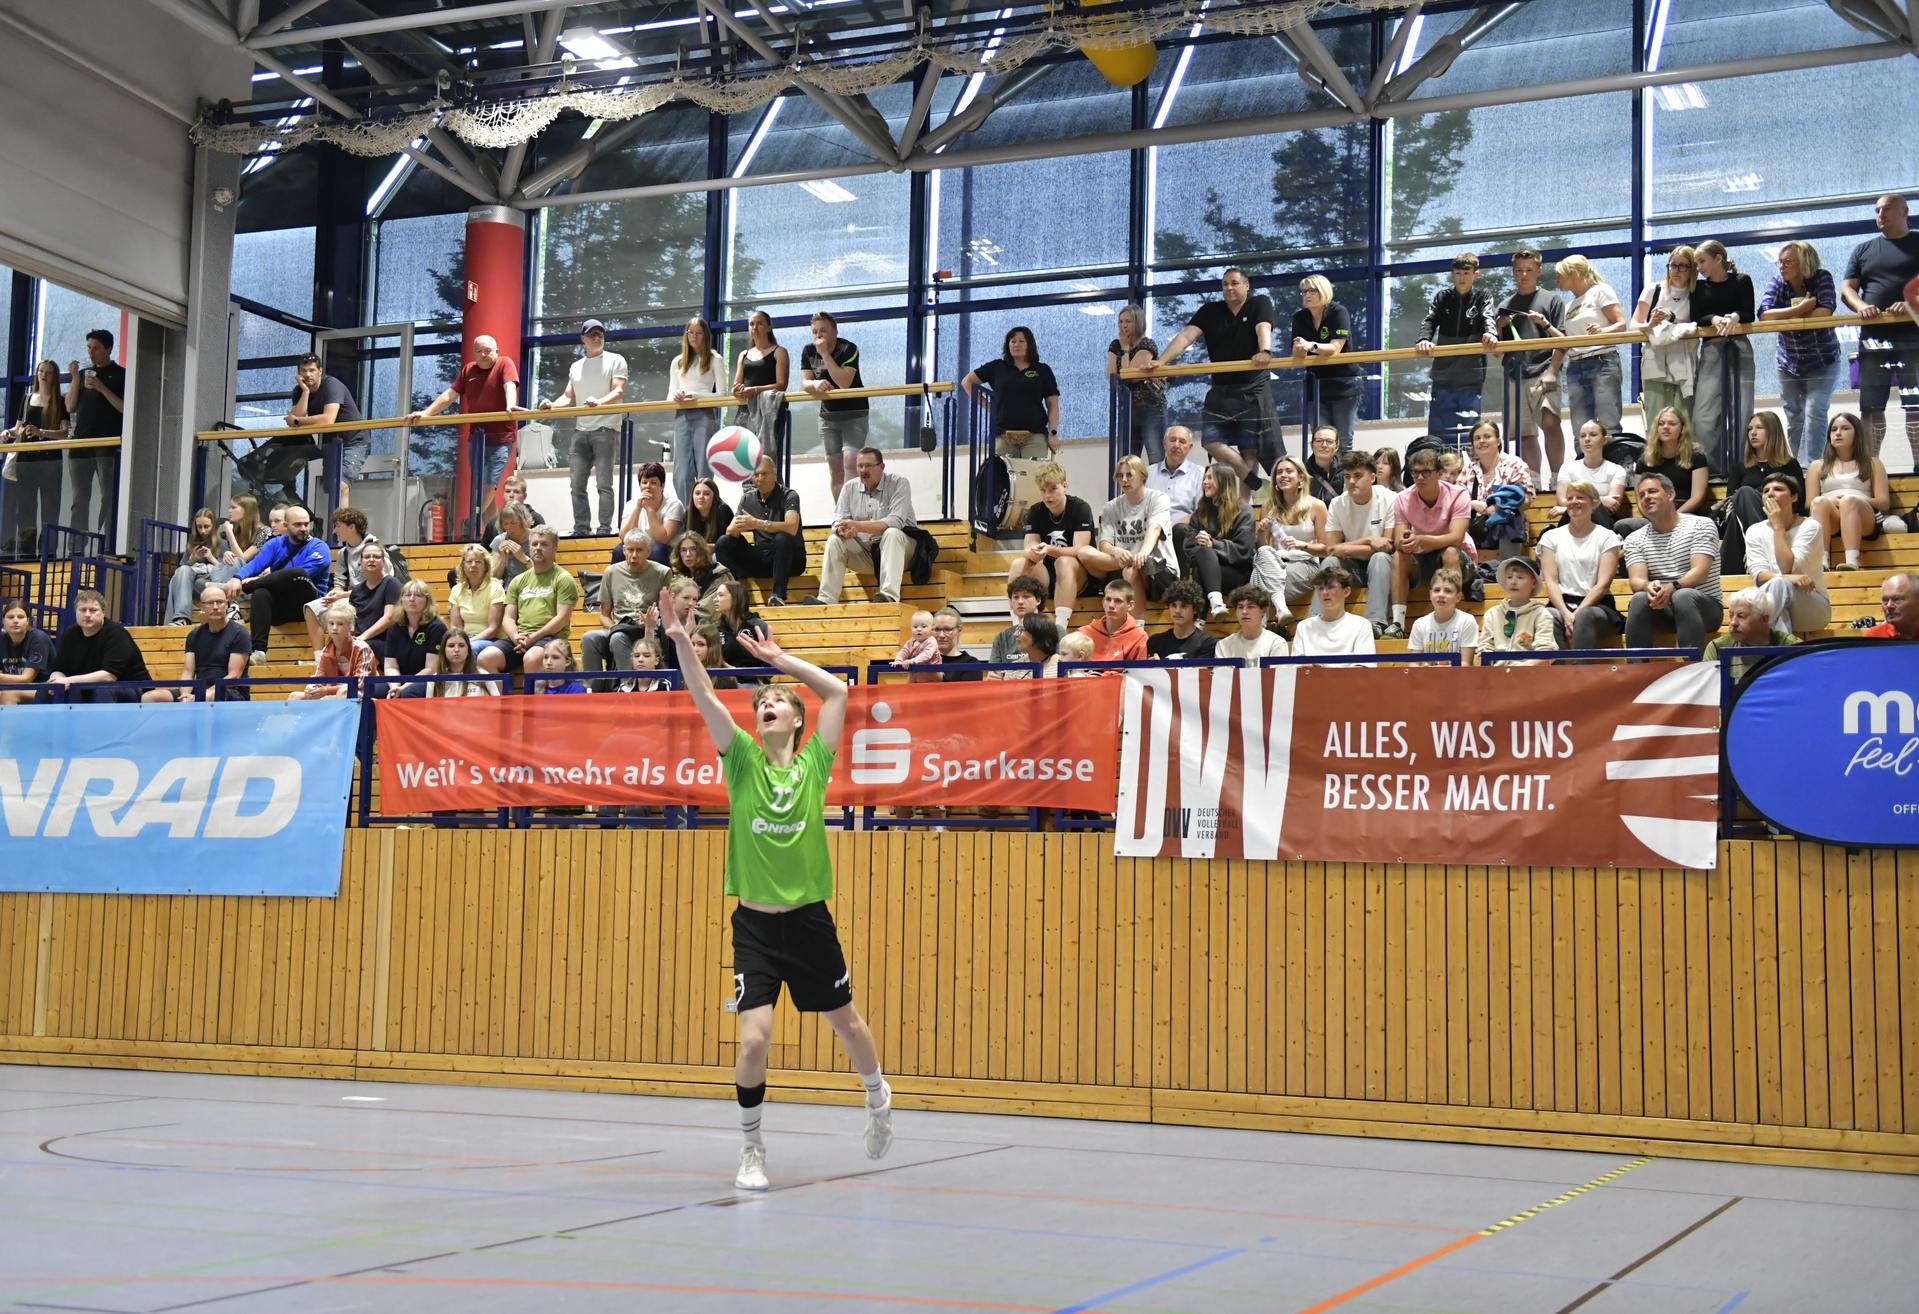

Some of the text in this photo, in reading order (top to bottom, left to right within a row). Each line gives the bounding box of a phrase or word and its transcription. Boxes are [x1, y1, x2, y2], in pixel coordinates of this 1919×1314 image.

[1843, 690, 1919, 734] m
[1323, 720, 1574, 766] ALLES, WAS UNS
[489, 762, 533, 784] um
[541, 757, 616, 785] mehr
[624, 757, 665, 785] als
[675, 757, 724, 785] Gel
[921, 750, 1095, 788] Sparkasse
[1323, 773, 1555, 812] BESSER MACHT.
